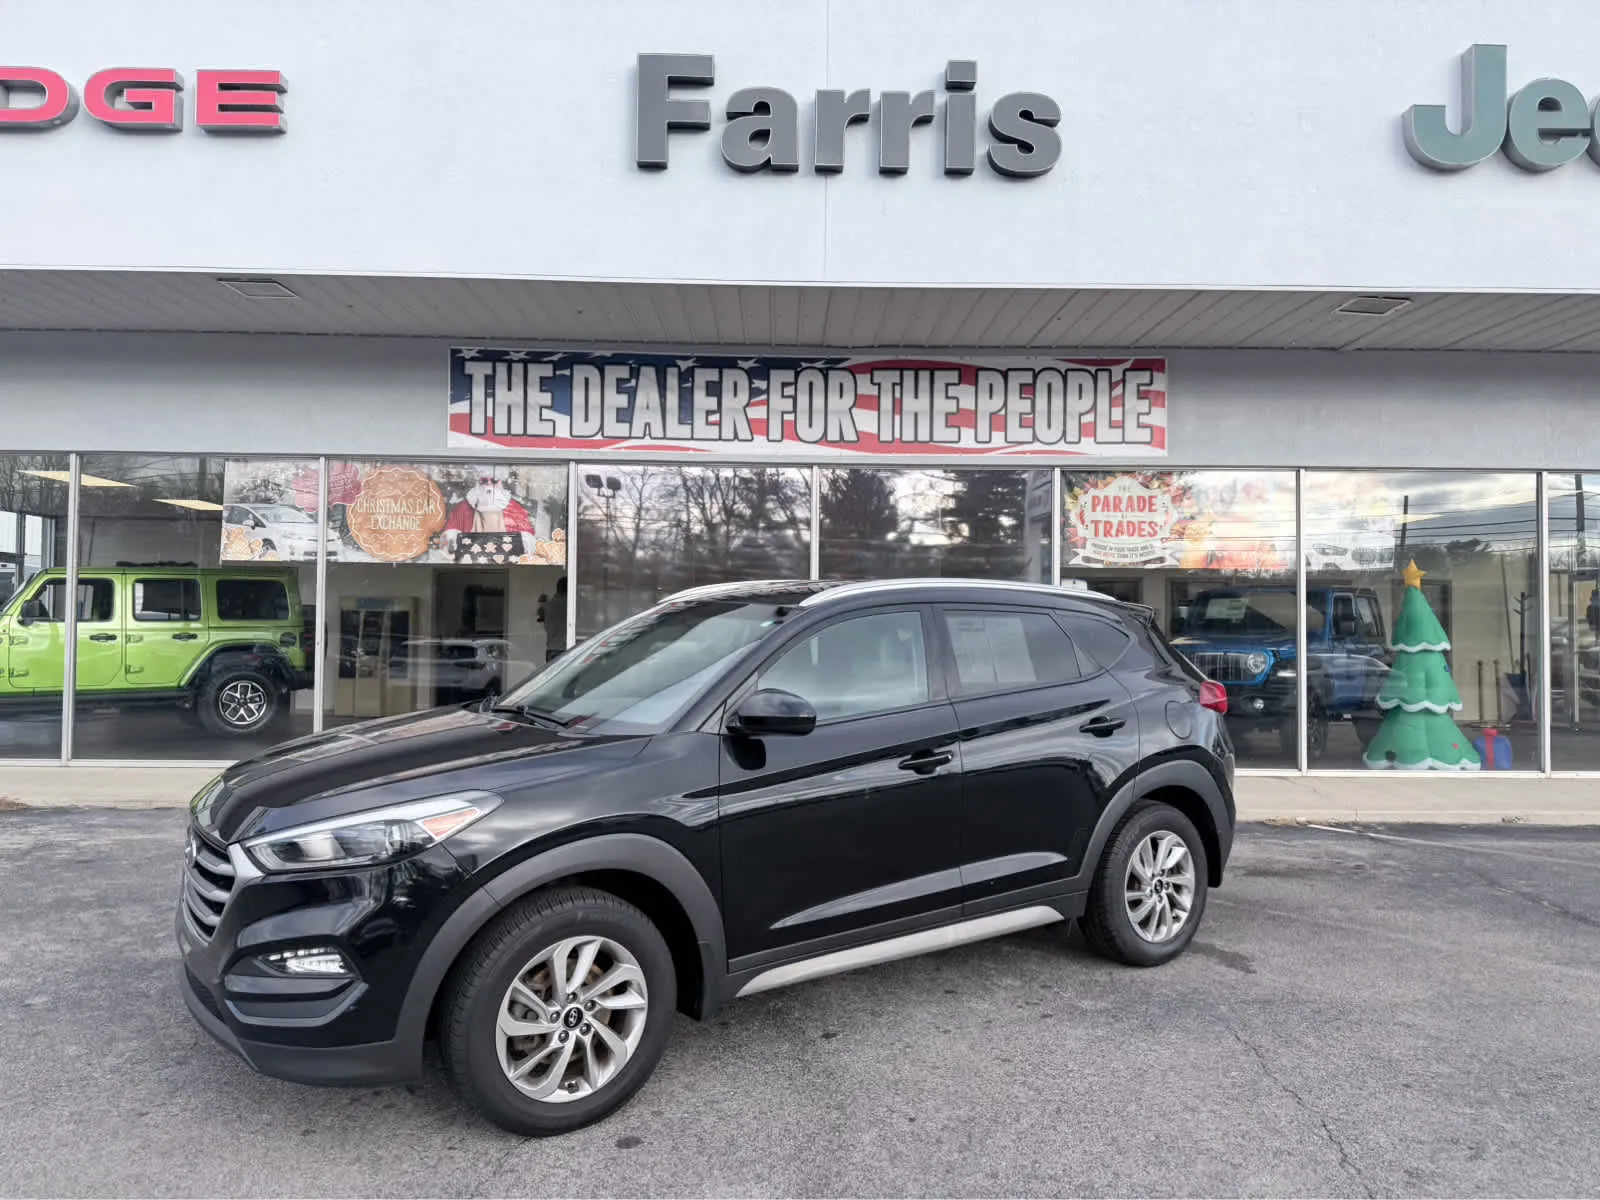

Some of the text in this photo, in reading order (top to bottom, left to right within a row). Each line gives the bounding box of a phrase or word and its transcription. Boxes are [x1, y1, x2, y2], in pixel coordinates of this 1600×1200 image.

[636, 53, 1063, 177] Farris
[1401, 44, 1600, 173] Je
[464, 359, 1154, 445] THE DEALER FOR THE PEOPLE
[357, 497, 436, 515] CHRISTMAS CAR
[1091, 495, 1158, 513] PARADE
[370, 515, 422, 530] EXCHANGE
[1091, 520, 1159, 538] TRADES
